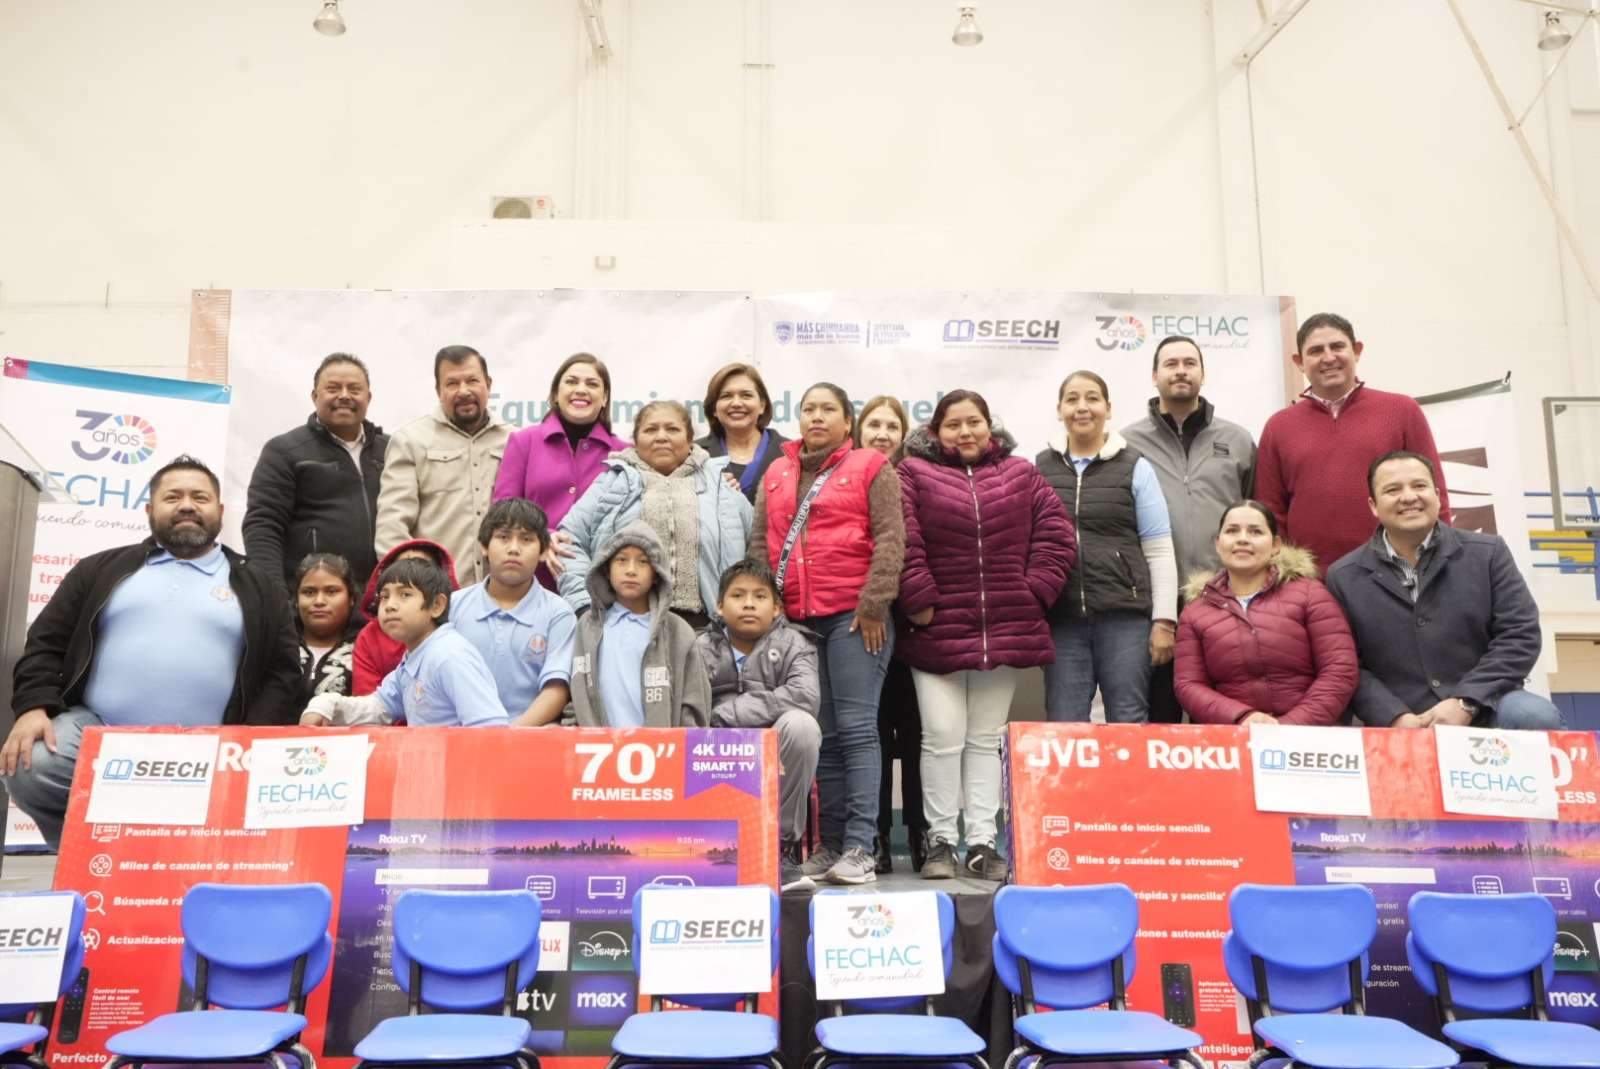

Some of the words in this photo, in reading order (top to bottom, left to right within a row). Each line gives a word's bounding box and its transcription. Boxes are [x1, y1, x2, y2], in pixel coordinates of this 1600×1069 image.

[977, 320, 1060, 338] SEECH
[1151, 315, 1248, 336] FECHAC
[92, 428, 140, 447] años
[32, 553, 80, 567] esario
[39, 571, 66, 585] tra
[692, 743, 716, 756] 4K
[719, 743, 756, 756] UHD
[1028, 739, 1100, 768] JVC
[1146, 739, 1241, 769] Roku
[692, 761, 735, 772] SMART
[737, 761, 756, 772] TV
[1287, 751, 1359, 770] SEECH
[134, 760, 209, 778] SEECH
[1449, 770, 1537, 794] FECHAC
[257, 781, 348, 804] FECHAC
[572, 787, 674, 801] FRAMELESS
[125, 827, 171, 837] Pantalla
[173, 827, 188, 836] de
[190, 827, 221, 837] inicio
[1074, 822, 1118, 832] Pantalla
[1120, 823, 1134, 832] de
[1136, 823, 1166, 832] inicio
[1168, 823, 1211, 833] sencilla
[378, 834, 409, 844] Roku
[410, 834, 427, 844] TV
[1320, 832, 1350, 843] Roku
[1351, 832, 1367, 843] TV
[119, 861, 149, 871] Miles
[152, 861, 166, 870] de
[169, 861, 213, 870] canales
[216, 861, 230, 870] de
[1076, 855, 1105, 865] Miles
[1107, 856, 1121, 865] de
[1123, 856, 1166, 865] canales
[1168, 857, 1182, 865] de
[112, 896, 169, 907] Búsqueda
[1171, 893, 1178, 902] y
[1383, 917, 1405, 926] gratis
[683, 919, 765, 939] SEECH
[0, 928, 62, 947] EECH
[825, 945, 922, 969] FECHAC
[1371, 963, 1381, 971] de
[576, 991, 628, 1008] max
[1548, 991, 1599, 1008] max
[52, 1052, 108, 1063] Perfecto
